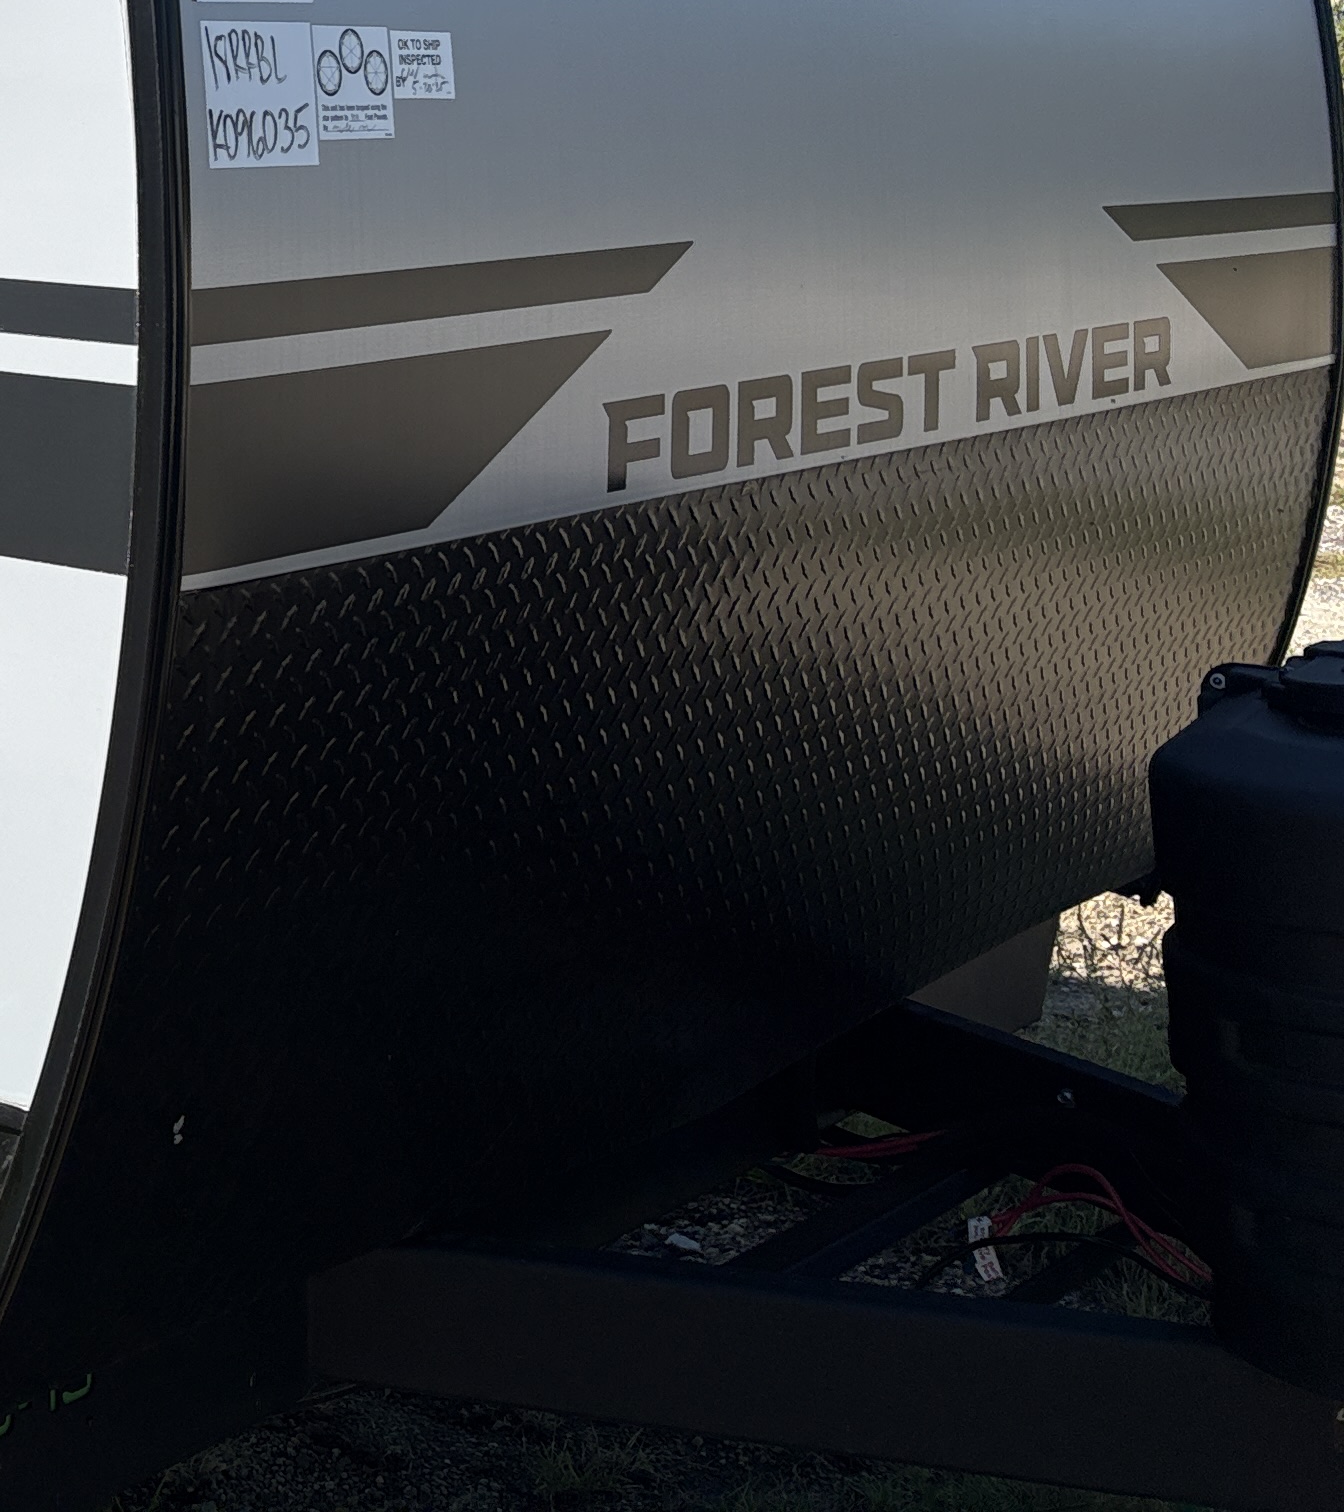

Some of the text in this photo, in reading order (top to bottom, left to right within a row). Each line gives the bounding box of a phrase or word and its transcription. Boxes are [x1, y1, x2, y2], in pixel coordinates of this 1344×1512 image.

[397, 39, 440, 50] OK TO SHIP
[398, 54, 441, 65] INSPECTED
[208, 102, 310, 161] K096035
[603, 317, 1172, 493] FOREST RIVER
